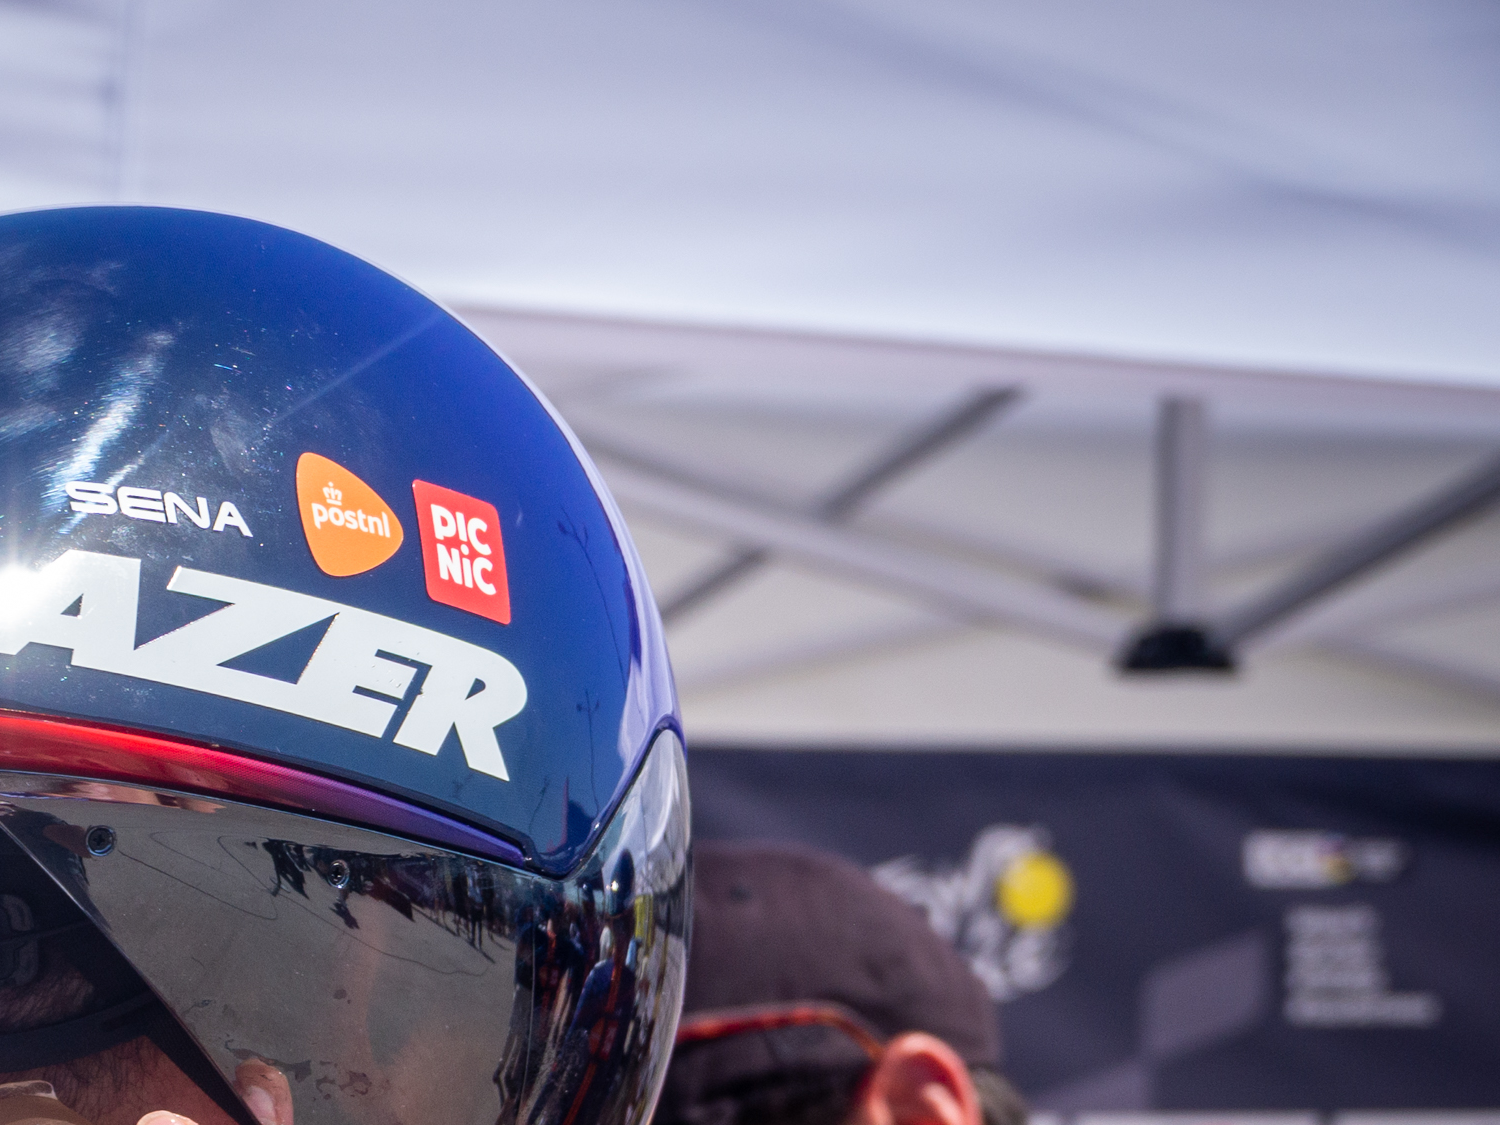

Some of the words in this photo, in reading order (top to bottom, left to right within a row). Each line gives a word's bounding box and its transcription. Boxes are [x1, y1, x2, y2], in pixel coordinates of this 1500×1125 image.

[65, 481, 253, 538] SENA
[311, 502, 391, 538] postnl
[430, 503, 492, 556] PIC
